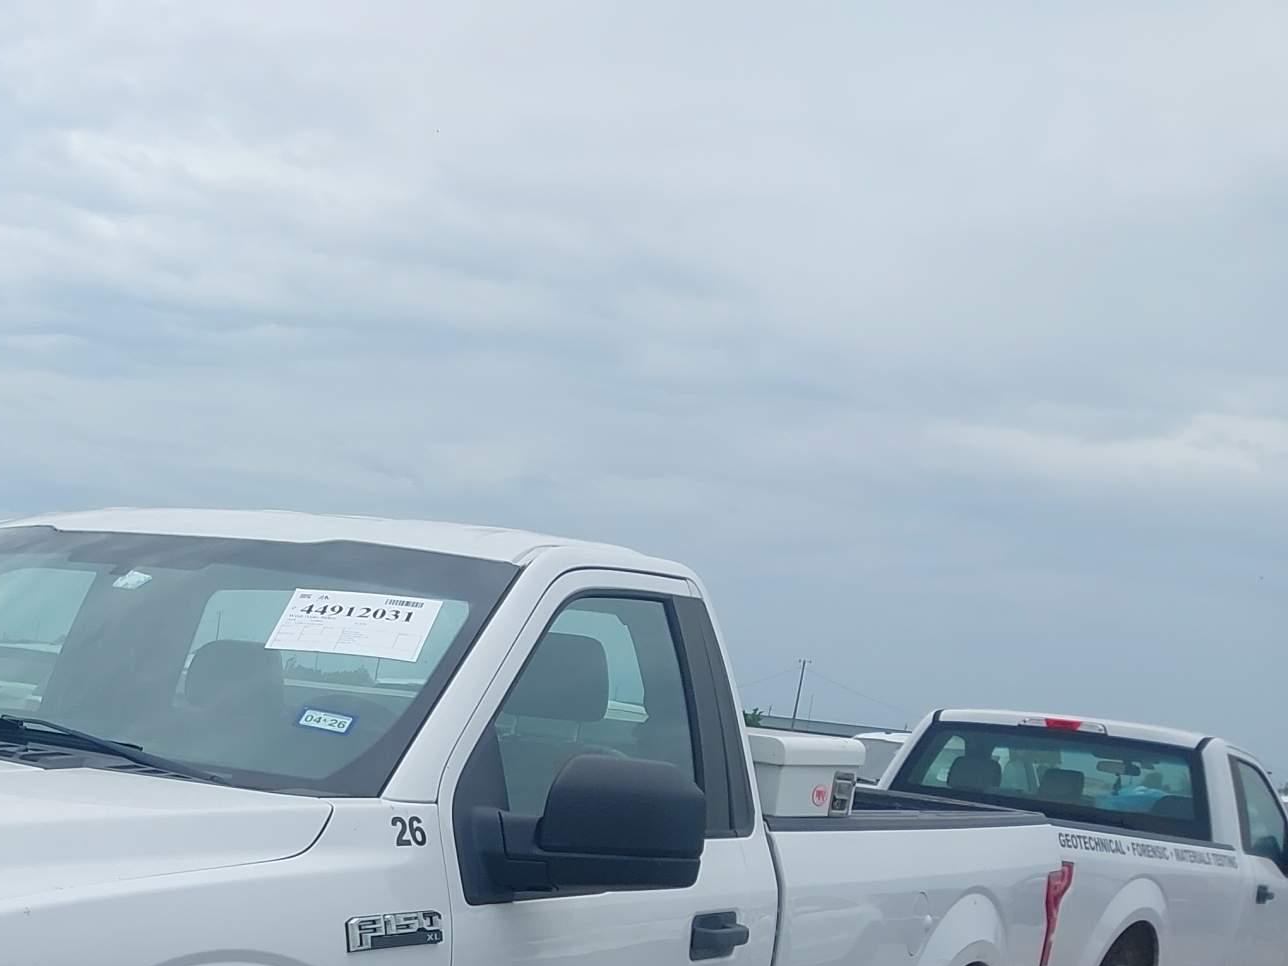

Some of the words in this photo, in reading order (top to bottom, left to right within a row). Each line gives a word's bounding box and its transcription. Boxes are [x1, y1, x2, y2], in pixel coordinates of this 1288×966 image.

[300, 603, 414, 623] 44912031
[391, 816, 427, 847] 26
[1058, 832, 1126, 855] GEOTECHNICAL
[1131, 842, 1170, 861] FORENSIC
[426, 933, 441, 942] XL
